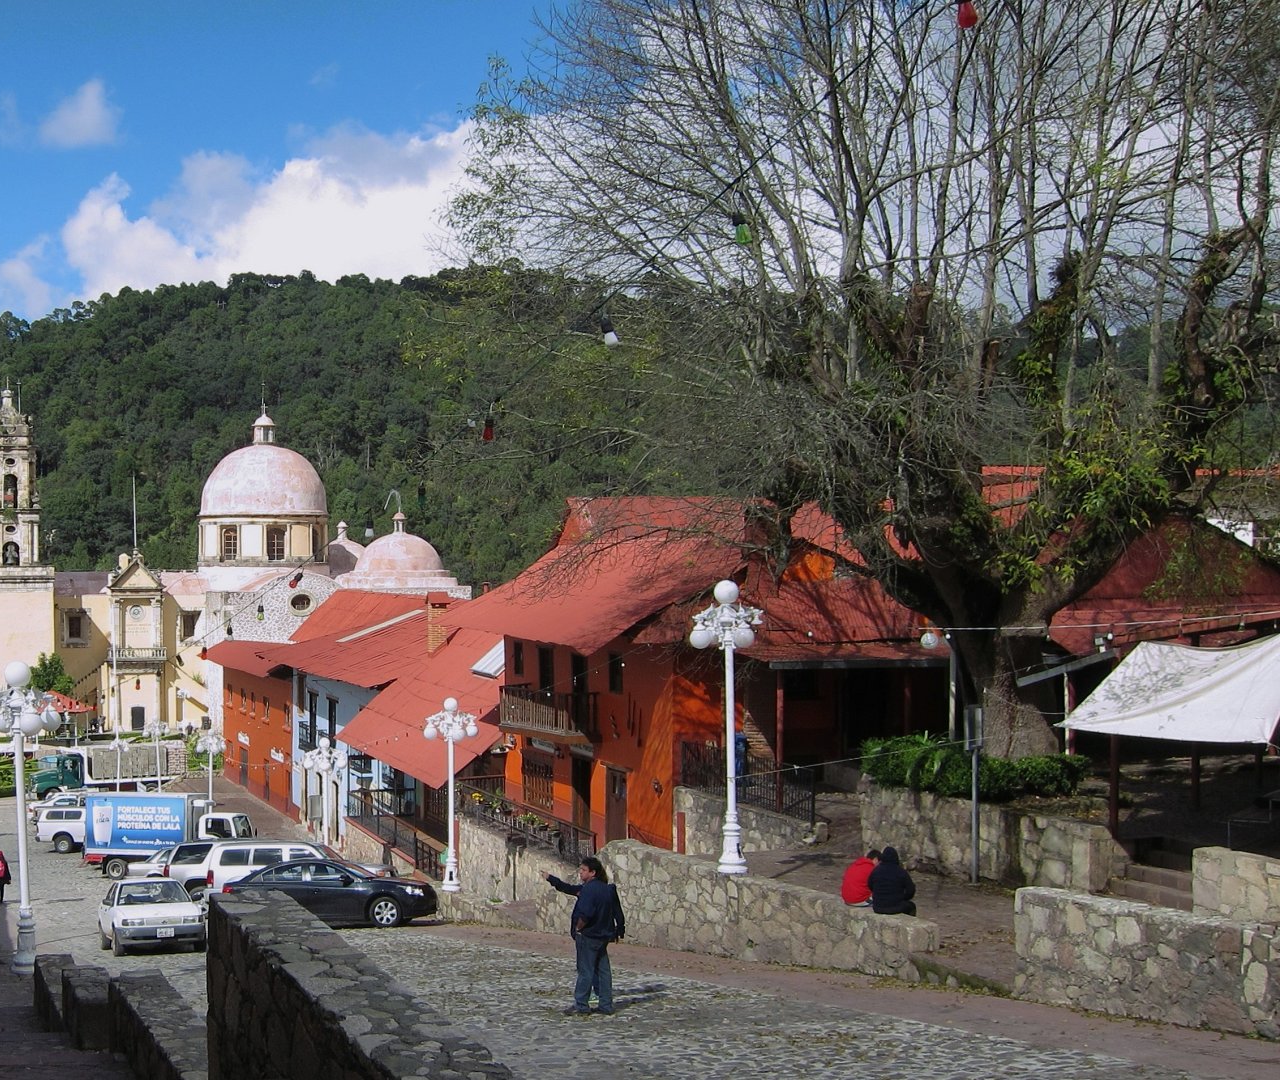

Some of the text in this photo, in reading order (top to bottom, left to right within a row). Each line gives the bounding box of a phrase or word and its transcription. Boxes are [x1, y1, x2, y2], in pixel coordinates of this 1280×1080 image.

[117, 805, 171, 814] FORTALECE TUS
[154, 814, 170, 822] CON
[170, 814, 180, 822] LA
[151, 822, 162, 830] DE
[162, 822, 181, 831] LALA
